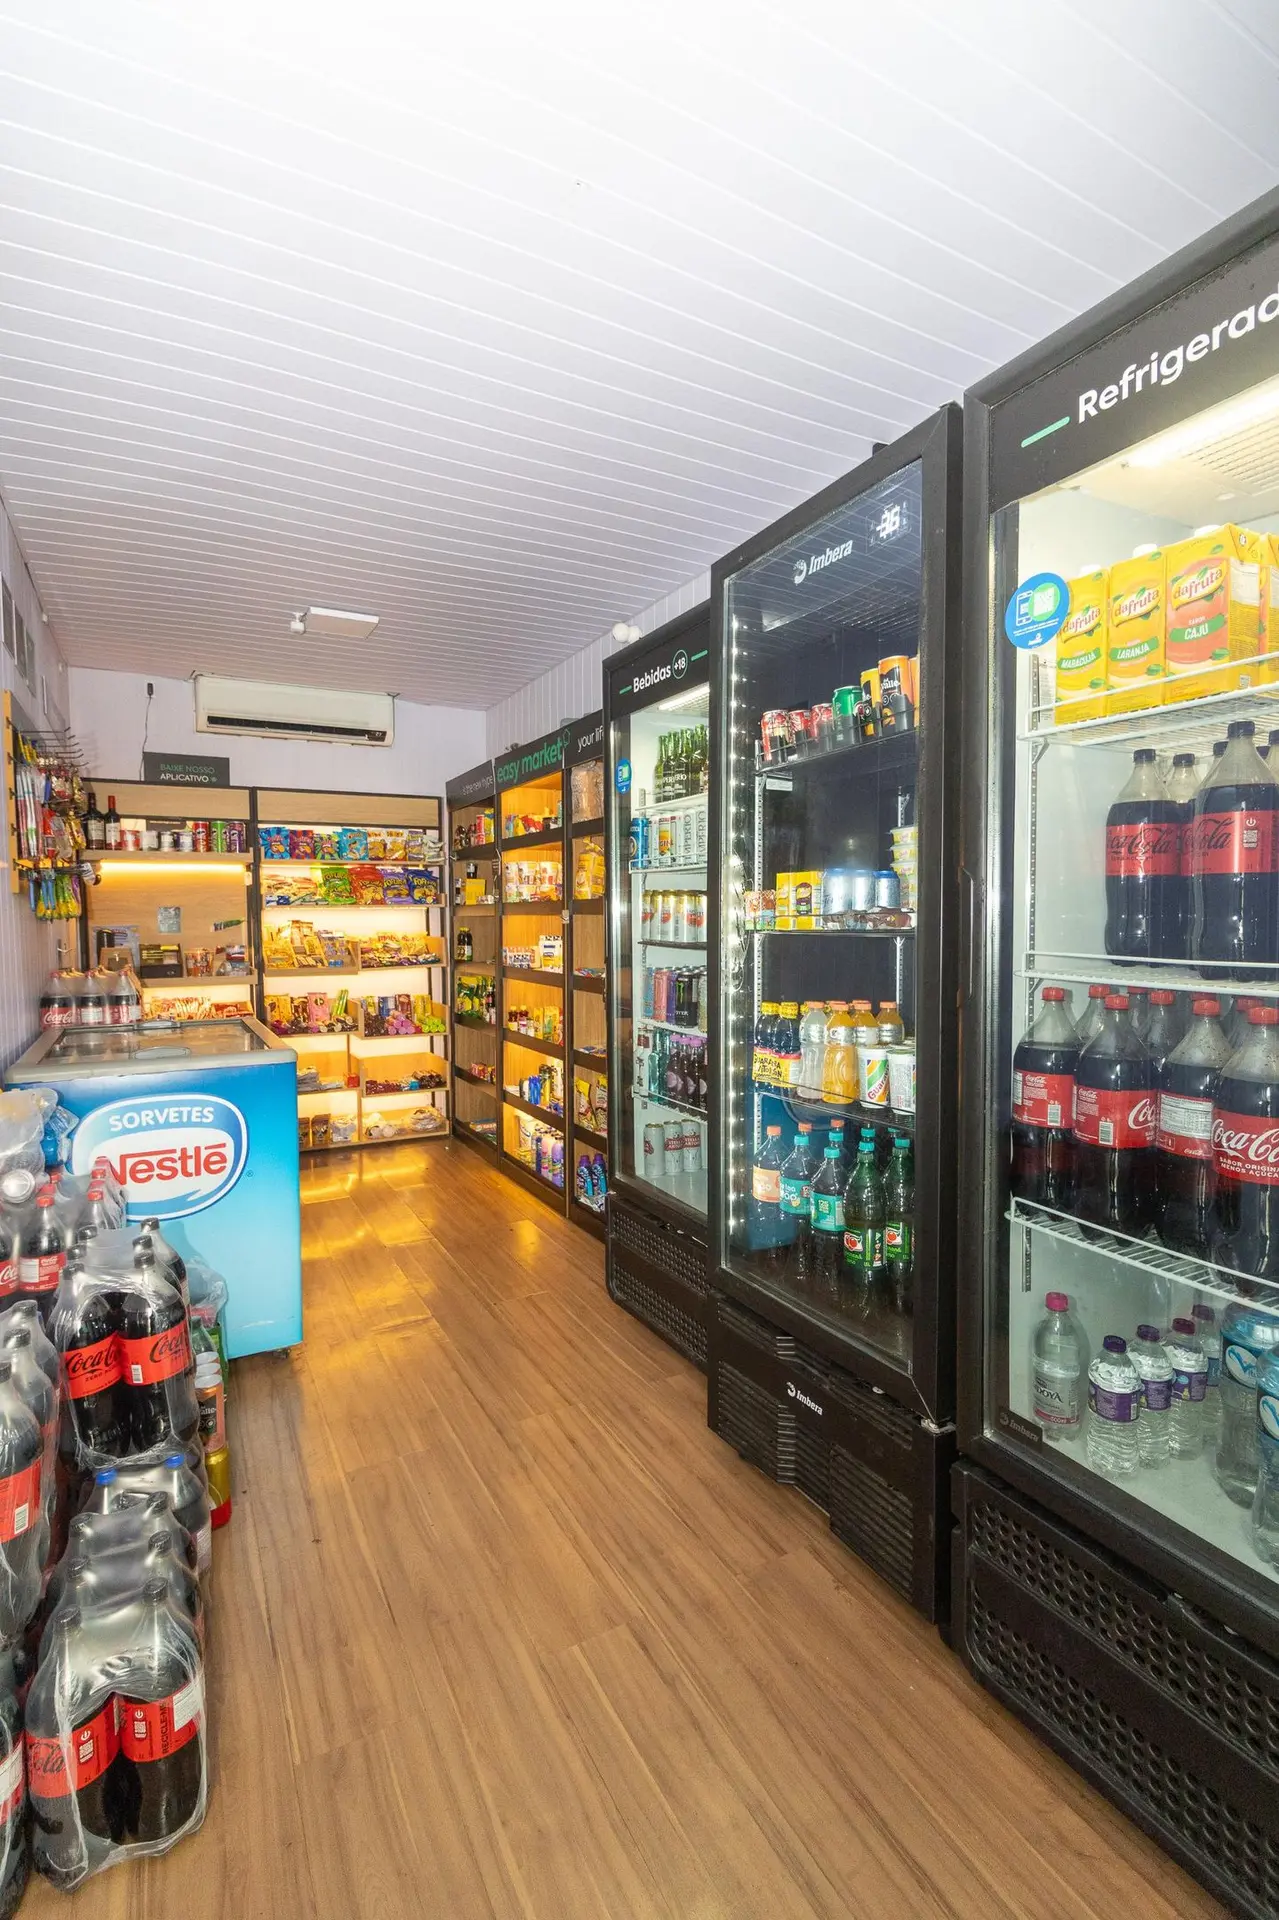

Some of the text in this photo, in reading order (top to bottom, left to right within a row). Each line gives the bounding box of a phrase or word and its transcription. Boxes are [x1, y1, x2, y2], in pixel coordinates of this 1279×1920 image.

[808, 539, 853, 576] Imbera
[1173, 568, 1223, 599] dafruta
[1115, 587, 1160, 618] dafruta
[1062, 607, 1101, 633] dafruta
[1184, 623, 1209, 640] CAJU
[1116, 642, 1150, 660] LARANJA
[633, 657, 686, 693] Bebidas +18
[577, 725, 604, 753] your lif
[160, 763, 215, 775] BAIXE NOSSO
[497, 760, 520, 784] easy
[521, 737, 562, 775] market
[160, 773, 209, 783] APLICATIVO
[109, 1106, 214, 1132] SORVETES
[107, 1143, 227, 1185] Nestlé
[1219, 1156, 1243, 1168] SABOR
[1220, 1163, 1247, 1173] MENOS
[796, 1390, 823, 1416] Imbera
